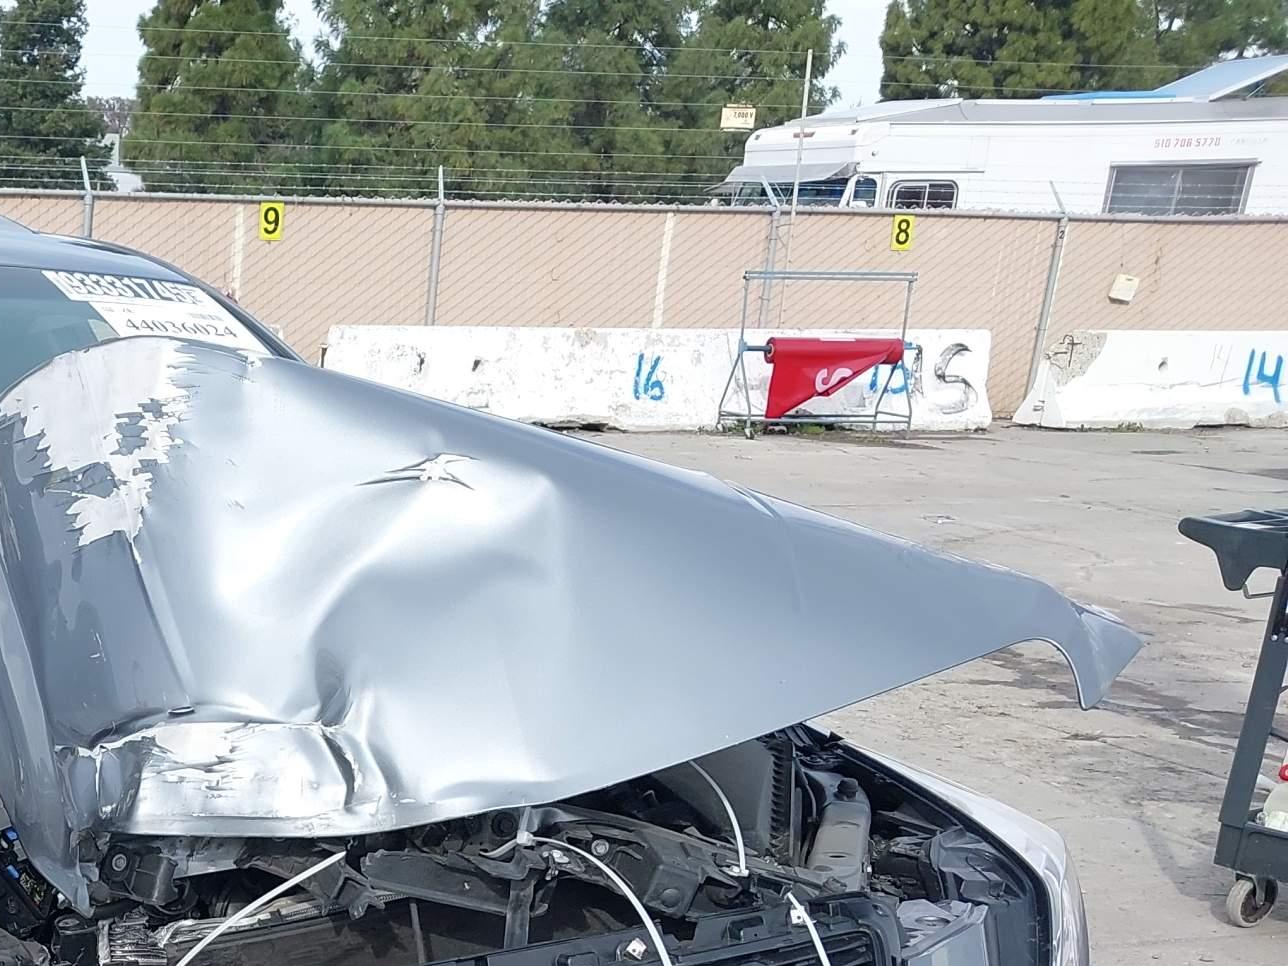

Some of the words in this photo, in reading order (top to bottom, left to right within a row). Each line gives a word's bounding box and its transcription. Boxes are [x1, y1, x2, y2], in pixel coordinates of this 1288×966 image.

[263, 206, 280, 235] 9
[895, 218, 911, 246] 8
[124, 317, 238, 339] 44036024
[633, 352, 665, 401] 16
[1242, 348, 1283, 404] 14
